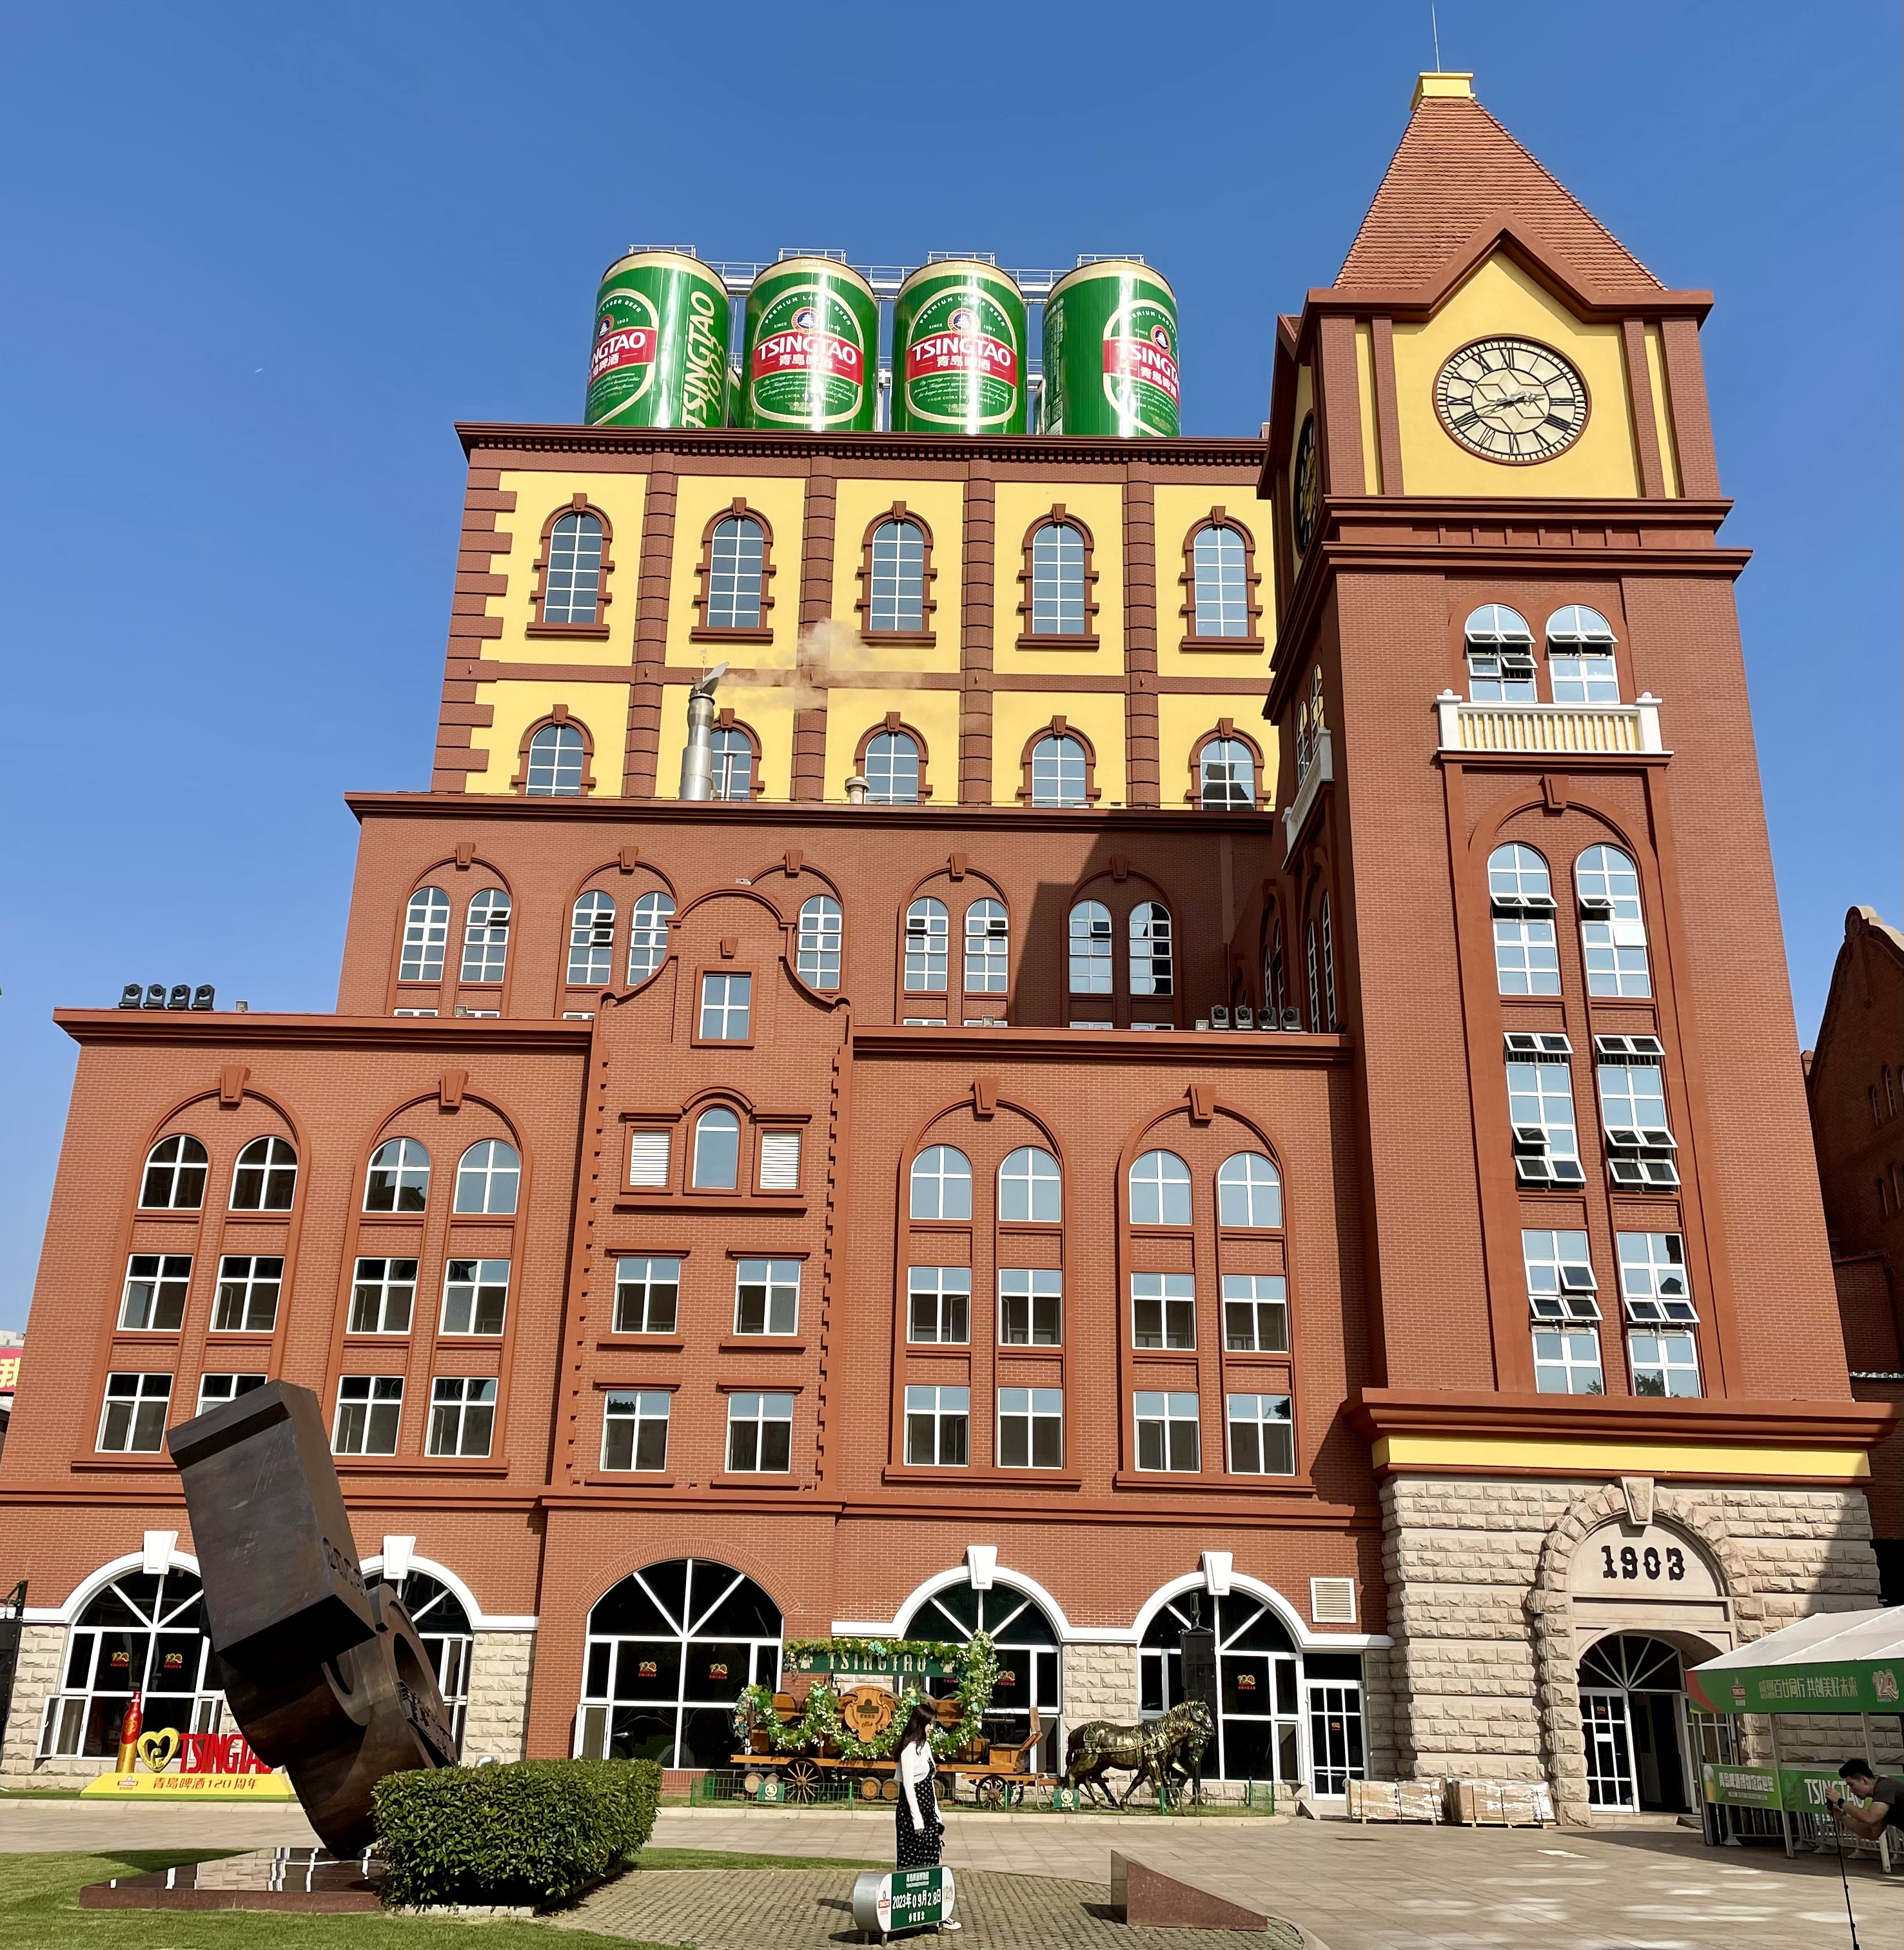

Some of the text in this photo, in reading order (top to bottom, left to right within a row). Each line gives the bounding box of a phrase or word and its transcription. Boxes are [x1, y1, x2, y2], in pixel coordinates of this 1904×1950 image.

[765, 296, 798, 324] PREMIUM
[802, 294, 831, 306] LAGR
[919, 297, 953, 324] PREMIUM
[591, 331, 646, 369] NGTAO
[681, 291, 715, 428] TSINGTAO
[757, 335, 857, 365] TSINGTAO
[911, 337, 1011, 367] TSINGTAO
[707, 335, 726, 416] 1903
[1601, 1545, 1686, 1581] 1903
[827, 1652, 927, 1673] TSINGTAO
[1807, 1675, 1859, 1699] 共创美好未来
[1872, 1668, 1899, 1701] 120
[179, 1733, 273, 1775] TSINGTA
